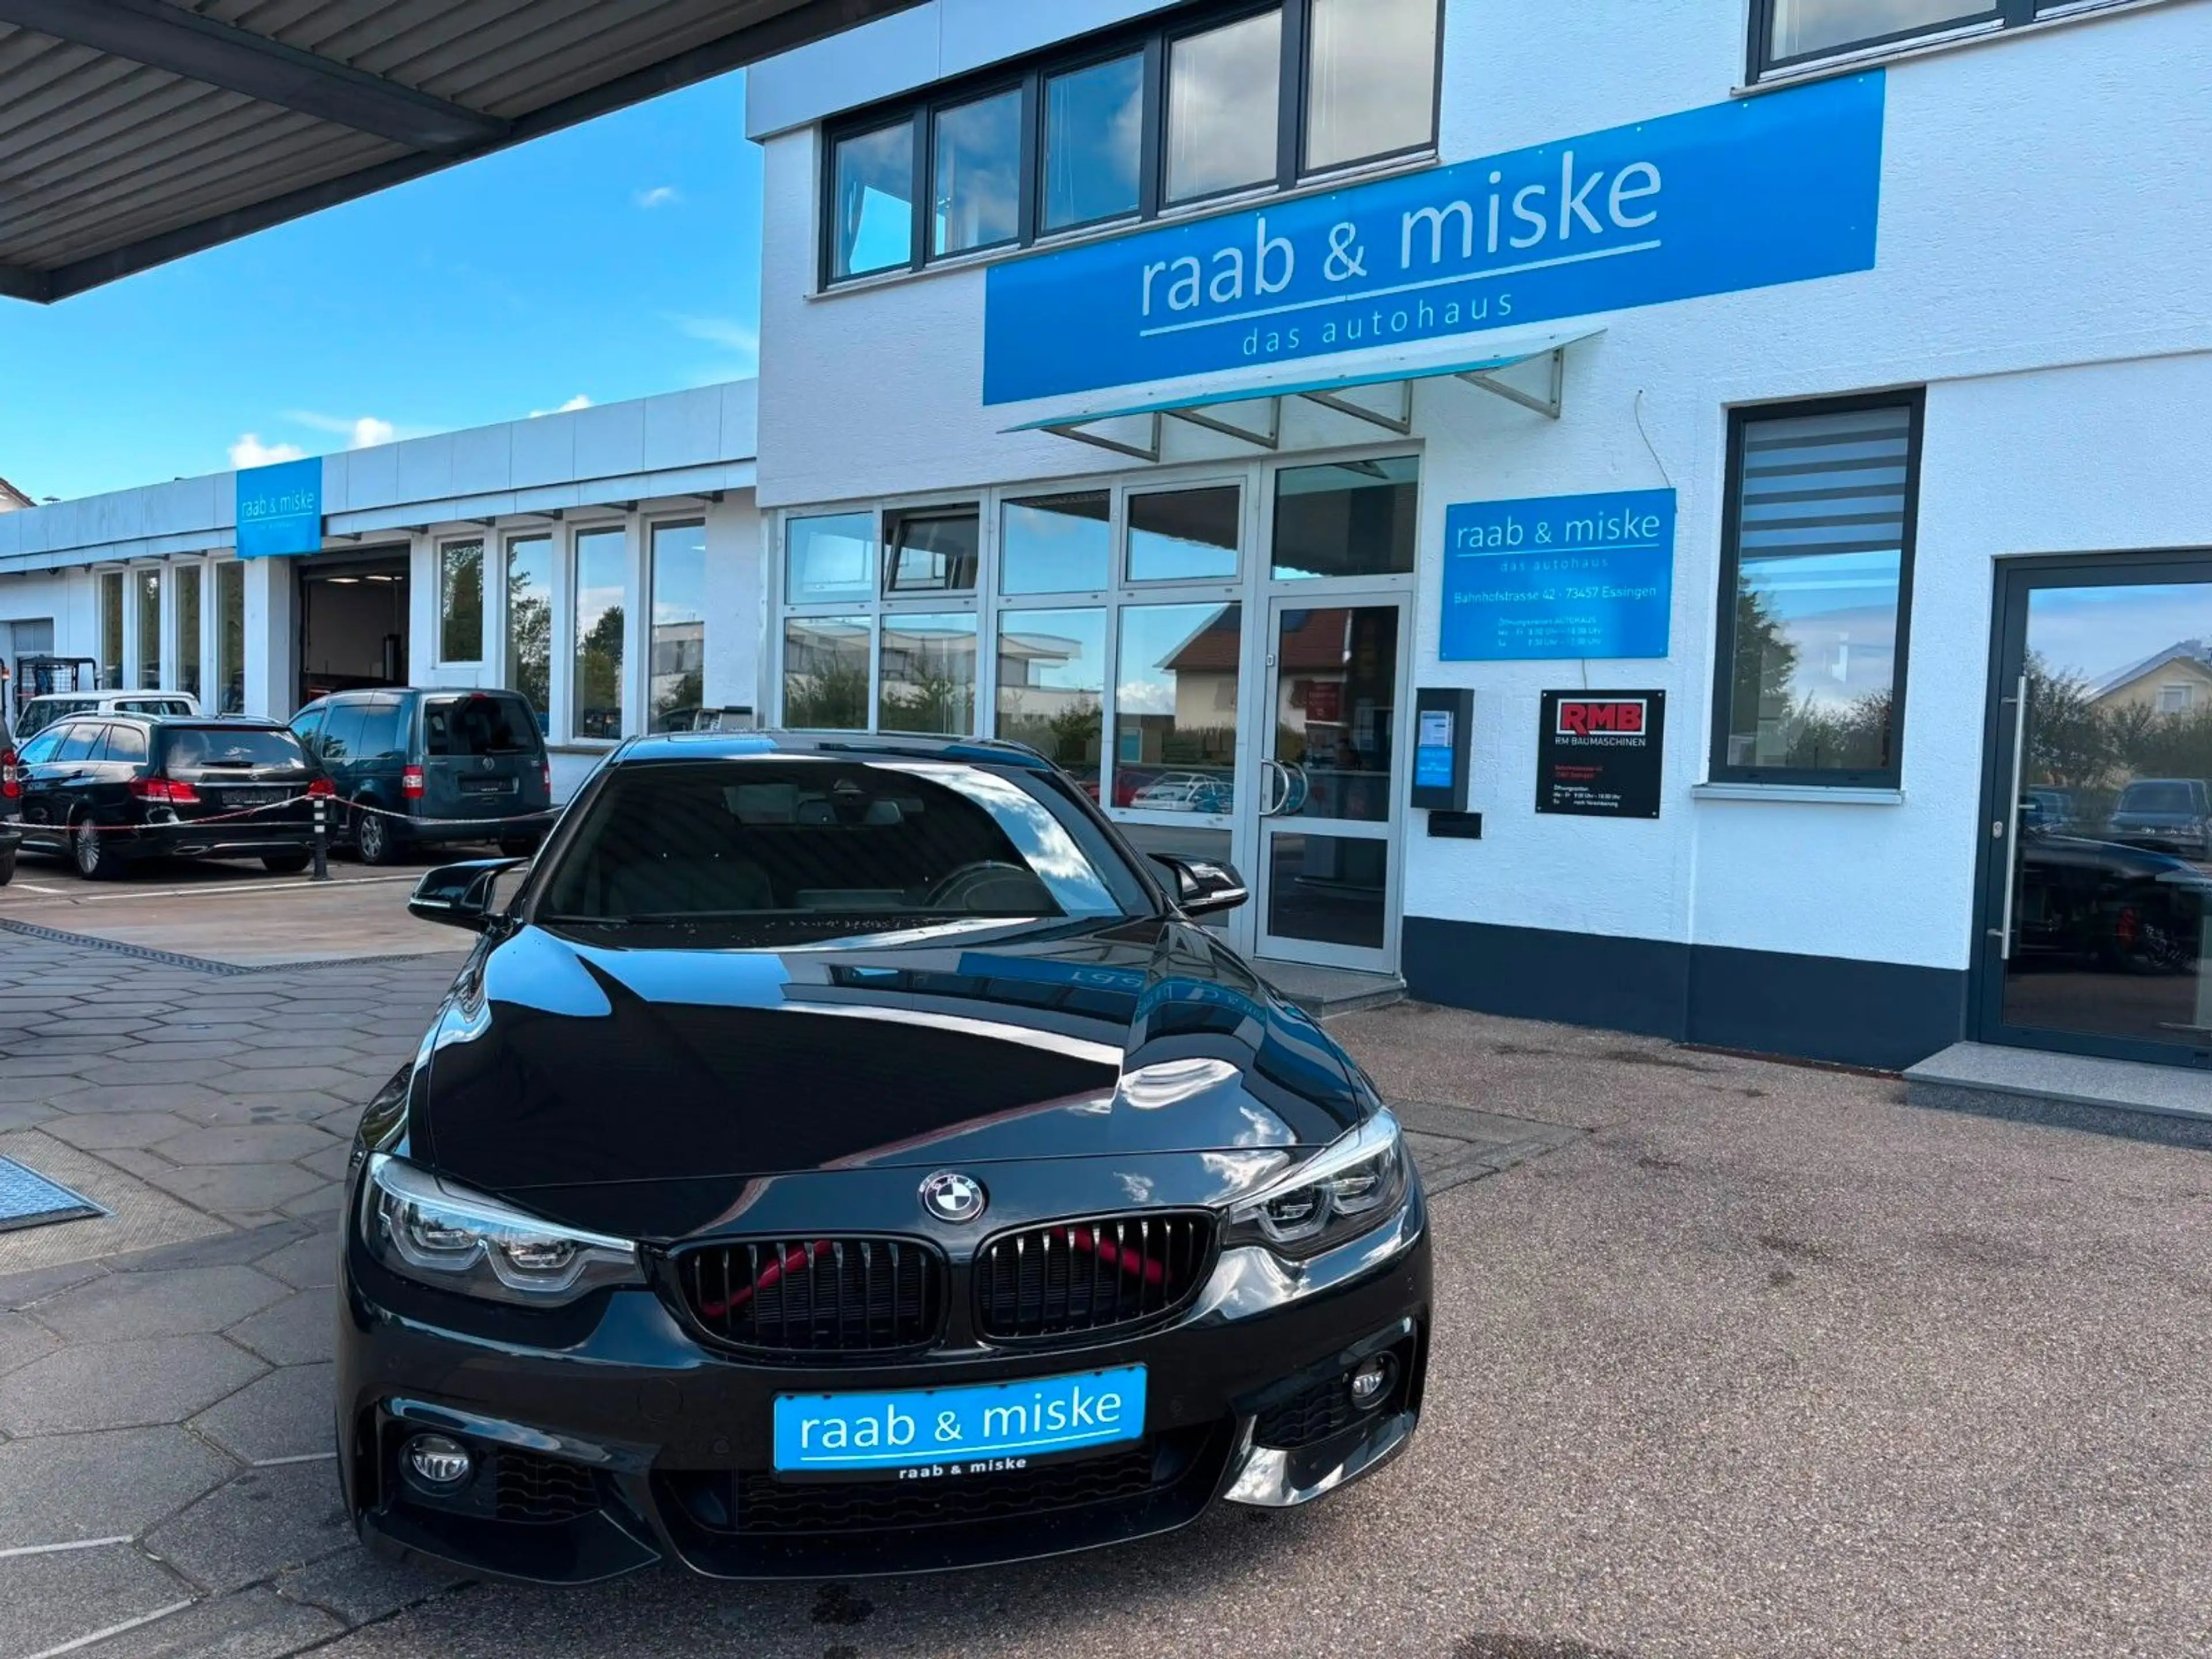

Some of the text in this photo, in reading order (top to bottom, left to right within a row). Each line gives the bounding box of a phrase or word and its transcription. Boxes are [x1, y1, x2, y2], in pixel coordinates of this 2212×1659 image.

[1141, 151, 1661, 316] raab & miske
[1243, 294, 1512, 355] das autohaus
[242, 488, 314, 517] raab & miske
[1456, 508, 1660, 548] raab & miske
[1500, 557, 1609, 572] das autohaus
[1454, 590, 1539, 604] Bahnhofstrasse
[1543, 588, 1555, 600] 42
[1601, 585, 1656, 601] Essingen
[1562, 704, 1641, 736] RMB
[1555, 737, 1646, 747] RM BAUMASCHINEN
[801, 1385, 1122, 1449] raab & miske
[899, 1457, 1027, 1479] raab & miske
